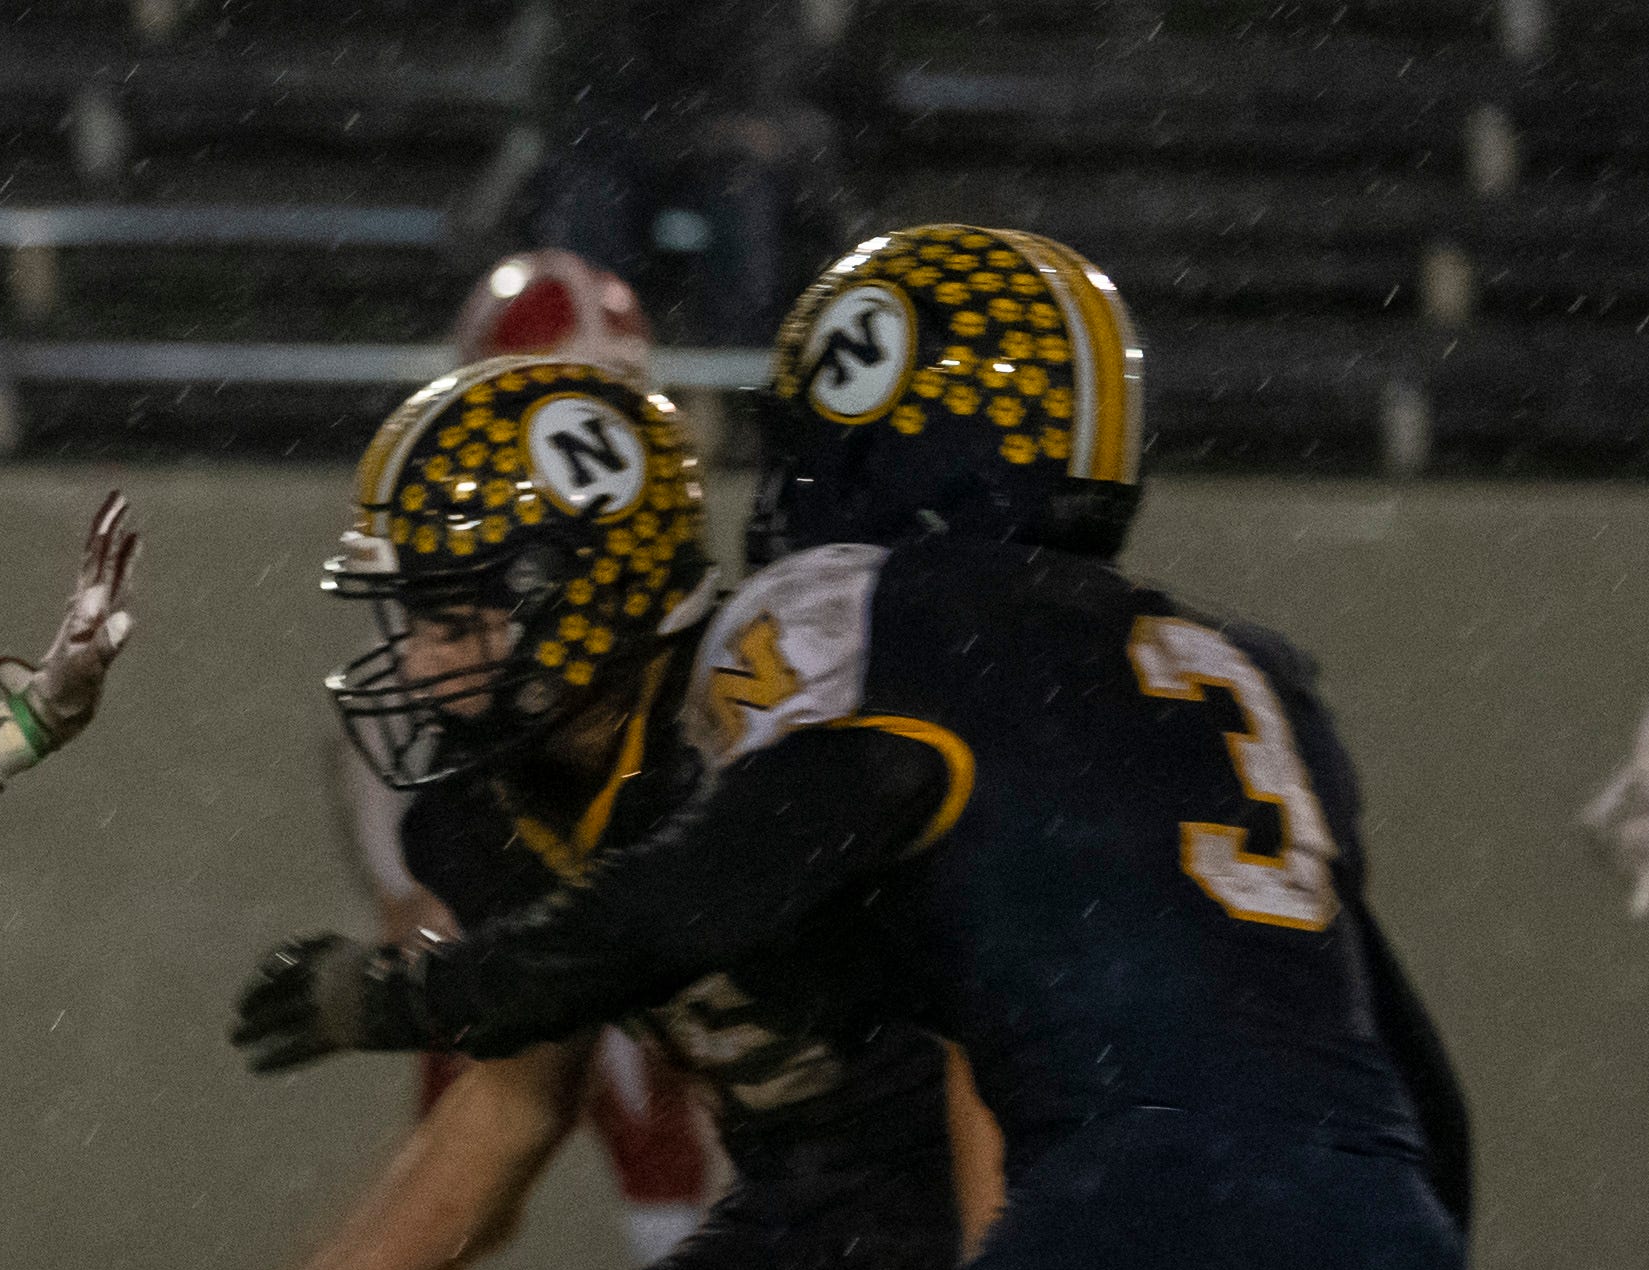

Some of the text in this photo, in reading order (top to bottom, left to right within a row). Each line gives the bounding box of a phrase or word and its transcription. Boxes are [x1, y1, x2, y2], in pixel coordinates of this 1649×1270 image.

[820, 308, 889, 386] N
[548, 418, 625, 488] N
[1126, 615, 1342, 932] 3
